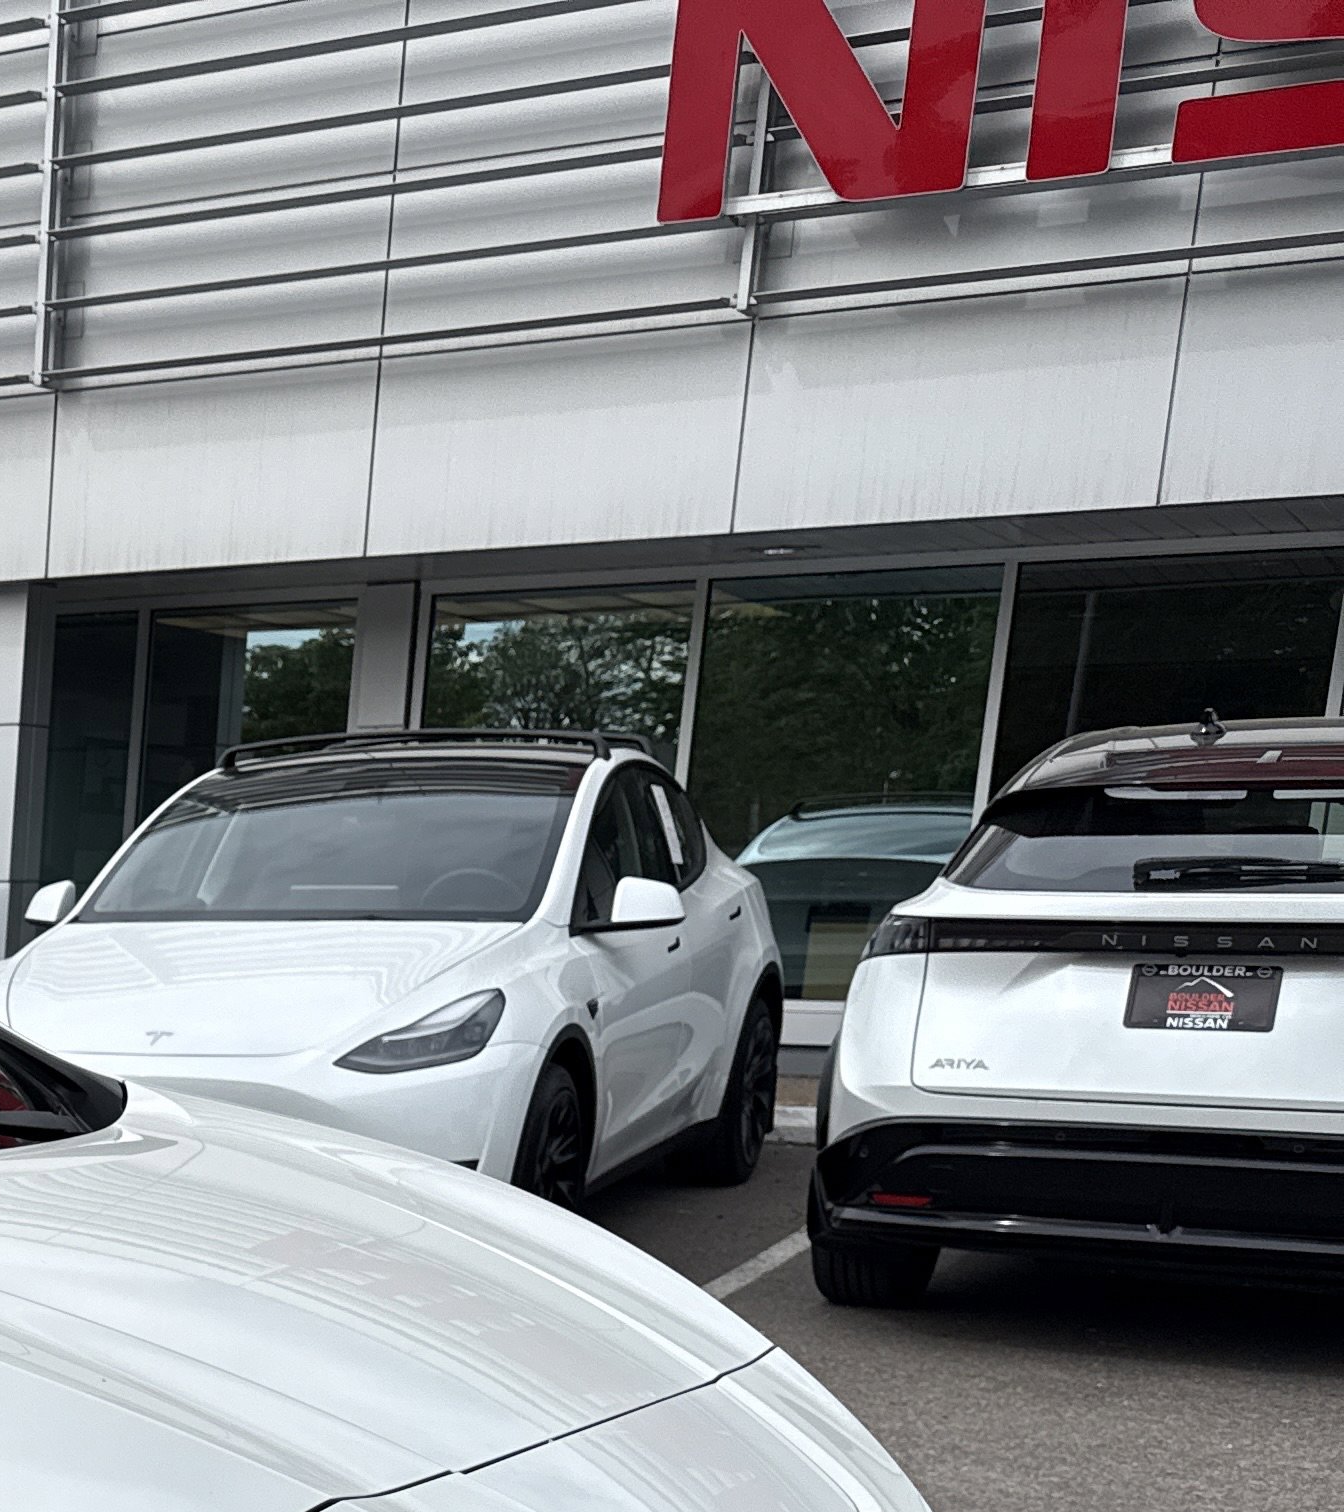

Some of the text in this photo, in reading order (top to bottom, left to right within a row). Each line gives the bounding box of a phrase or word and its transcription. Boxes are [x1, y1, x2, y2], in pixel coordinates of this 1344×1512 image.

[1100, 932, 1319, 950] NISSAN
[1168, 964, 1246, 977] BOULDER
[1167, 1000, 1234, 1012] NISSAN
[1166, 1016, 1229, 1029] NISSAN
[929, 1056, 990, 1071] ARIYA
